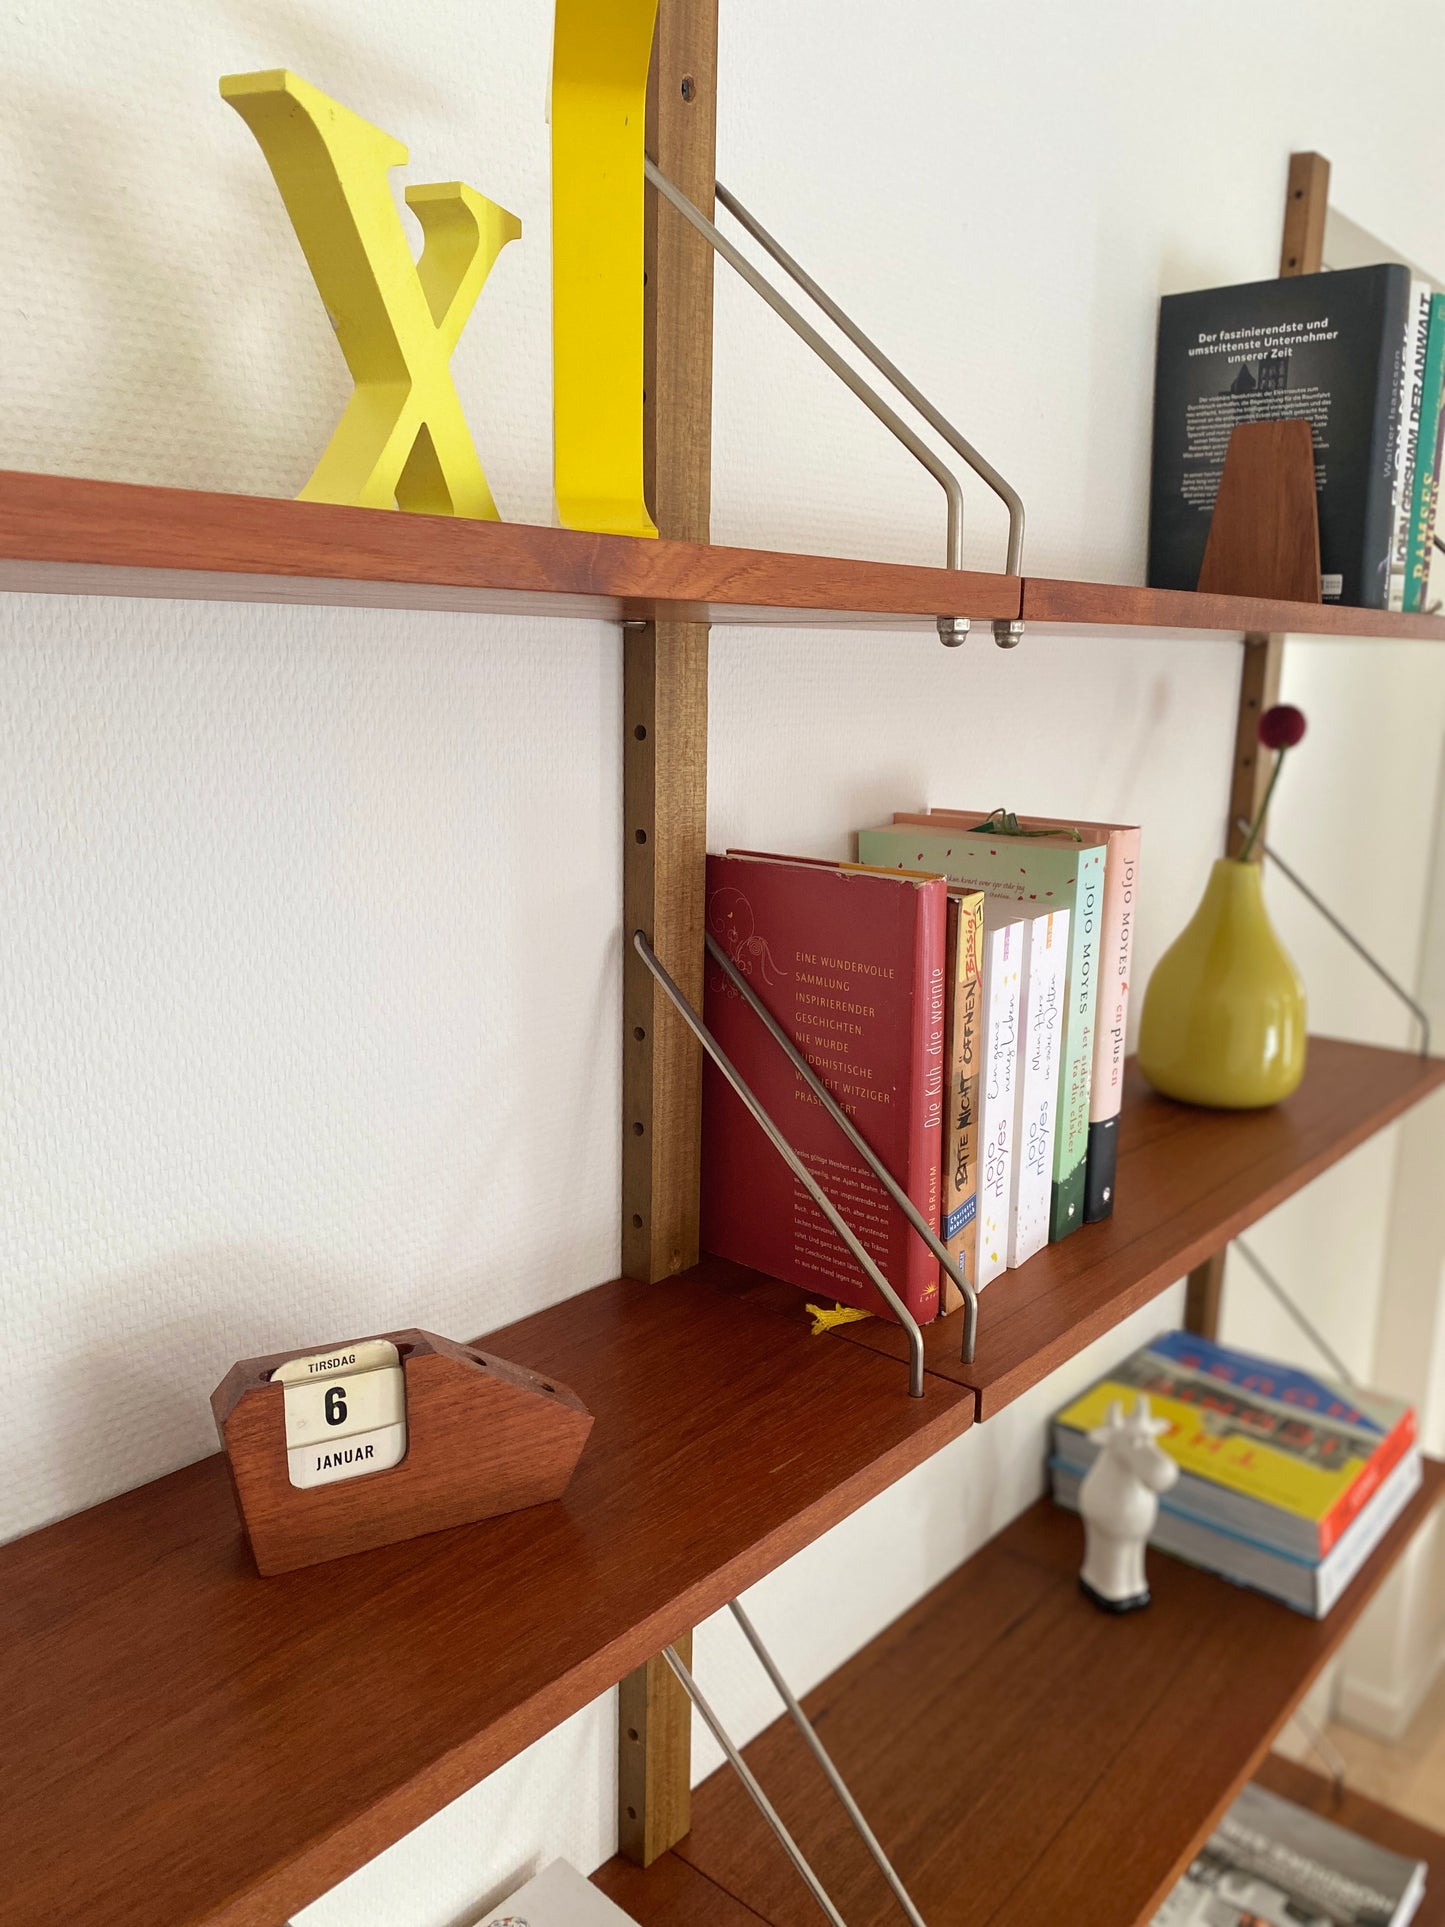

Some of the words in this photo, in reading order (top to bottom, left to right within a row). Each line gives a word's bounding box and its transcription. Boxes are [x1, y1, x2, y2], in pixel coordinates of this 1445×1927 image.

[1188, 339, 1261, 357] umstrittenste
[1264, 331, 1338, 347] Unternehmer
[1198, 333, 1217, 344] Der
[1219, 322, 1303, 341] faszinierendste
[1306, 317, 1329, 329] und
[1414, 292, 1431, 380] ANWALT
[1228, 352, 1269, 363] unserer
[1271, 347, 1293, 359] Zeit
[1388, 350, 1400, 419] Isaacson
[1410, 383, 1423, 423] DER
[1383, 425, 1394, 477] Walter
[1401, 428, 1418, 513] GRISHAM
[1396, 516, 1409, 562] JOHN
[1413, 472, 1433, 579] RAMSES
[1121, 858, 1135, 904] JOJO
[1081, 883, 1095, 934] JOJO
[963, 910, 975, 980] Bissig!
[1119, 913, 1131, 976] MOYES
[795, 971, 850, 991] SAMMLUNG
[796, 951, 817, 964] EINE
[820, 956, 895, 979] WUNDERVOLLE
[1079, 944, 1091, 1014] MOYES
[795, 992, 875, 1018] INSPIRIERENDER
[928, 968, 944, 1023] weinte
[795, 1012, 864, 1036] GESCHICHTEN.
[959, 980, 978, 1064] ÖFFNEN
[1000, 993, 1015, 1047] Leben
[795, 1032, 811, 1044] NIE
[815, 1036, 849, 1053] WURDE
[927, 1032, 942, 1055] die
[1031, 1033, 1041, 1071] Mein
[801, 1053, 873, 1079] DDHISTISCHE
[842, 1083, 890, 1103] WITZIGER
[956, 1070, 973, 1130] NICHT
[924, 1103, 941, 1128] Die
[928, 1166, 937, 1211] BRAHM
[950, 1201, 974, 1224] Charlotte
[308, 1353, 356, 1374] TIRSDAG
[324, 1386, 348, 1426] 6
[316, 1444, 375, 1472] JANUAR
